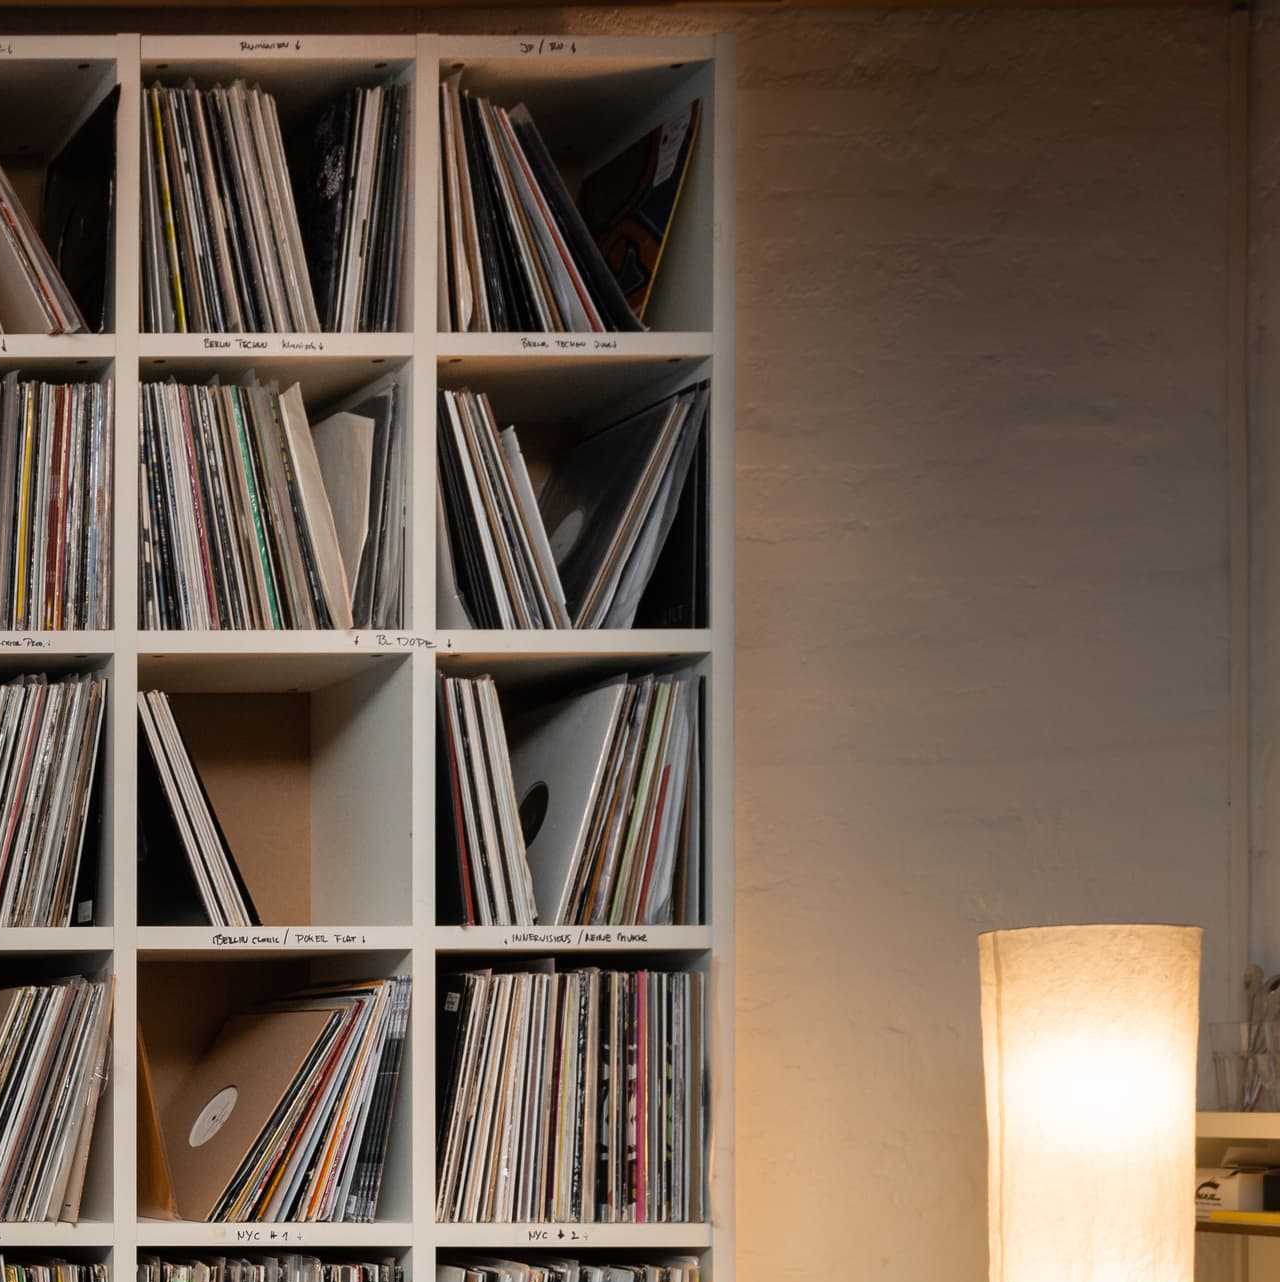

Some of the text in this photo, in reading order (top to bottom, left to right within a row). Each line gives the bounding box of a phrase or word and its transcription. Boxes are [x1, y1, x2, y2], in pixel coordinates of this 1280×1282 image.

[204, 338, 230, 348] BERLIN
[295, 934, 328, 943] POKER
[334, 935, 356, 943] FLAT
[238, 1230, 260, 1240] NYC
[529, 1231, 547, 1240] NYC
[571, 1231, 579, 1240] 2
